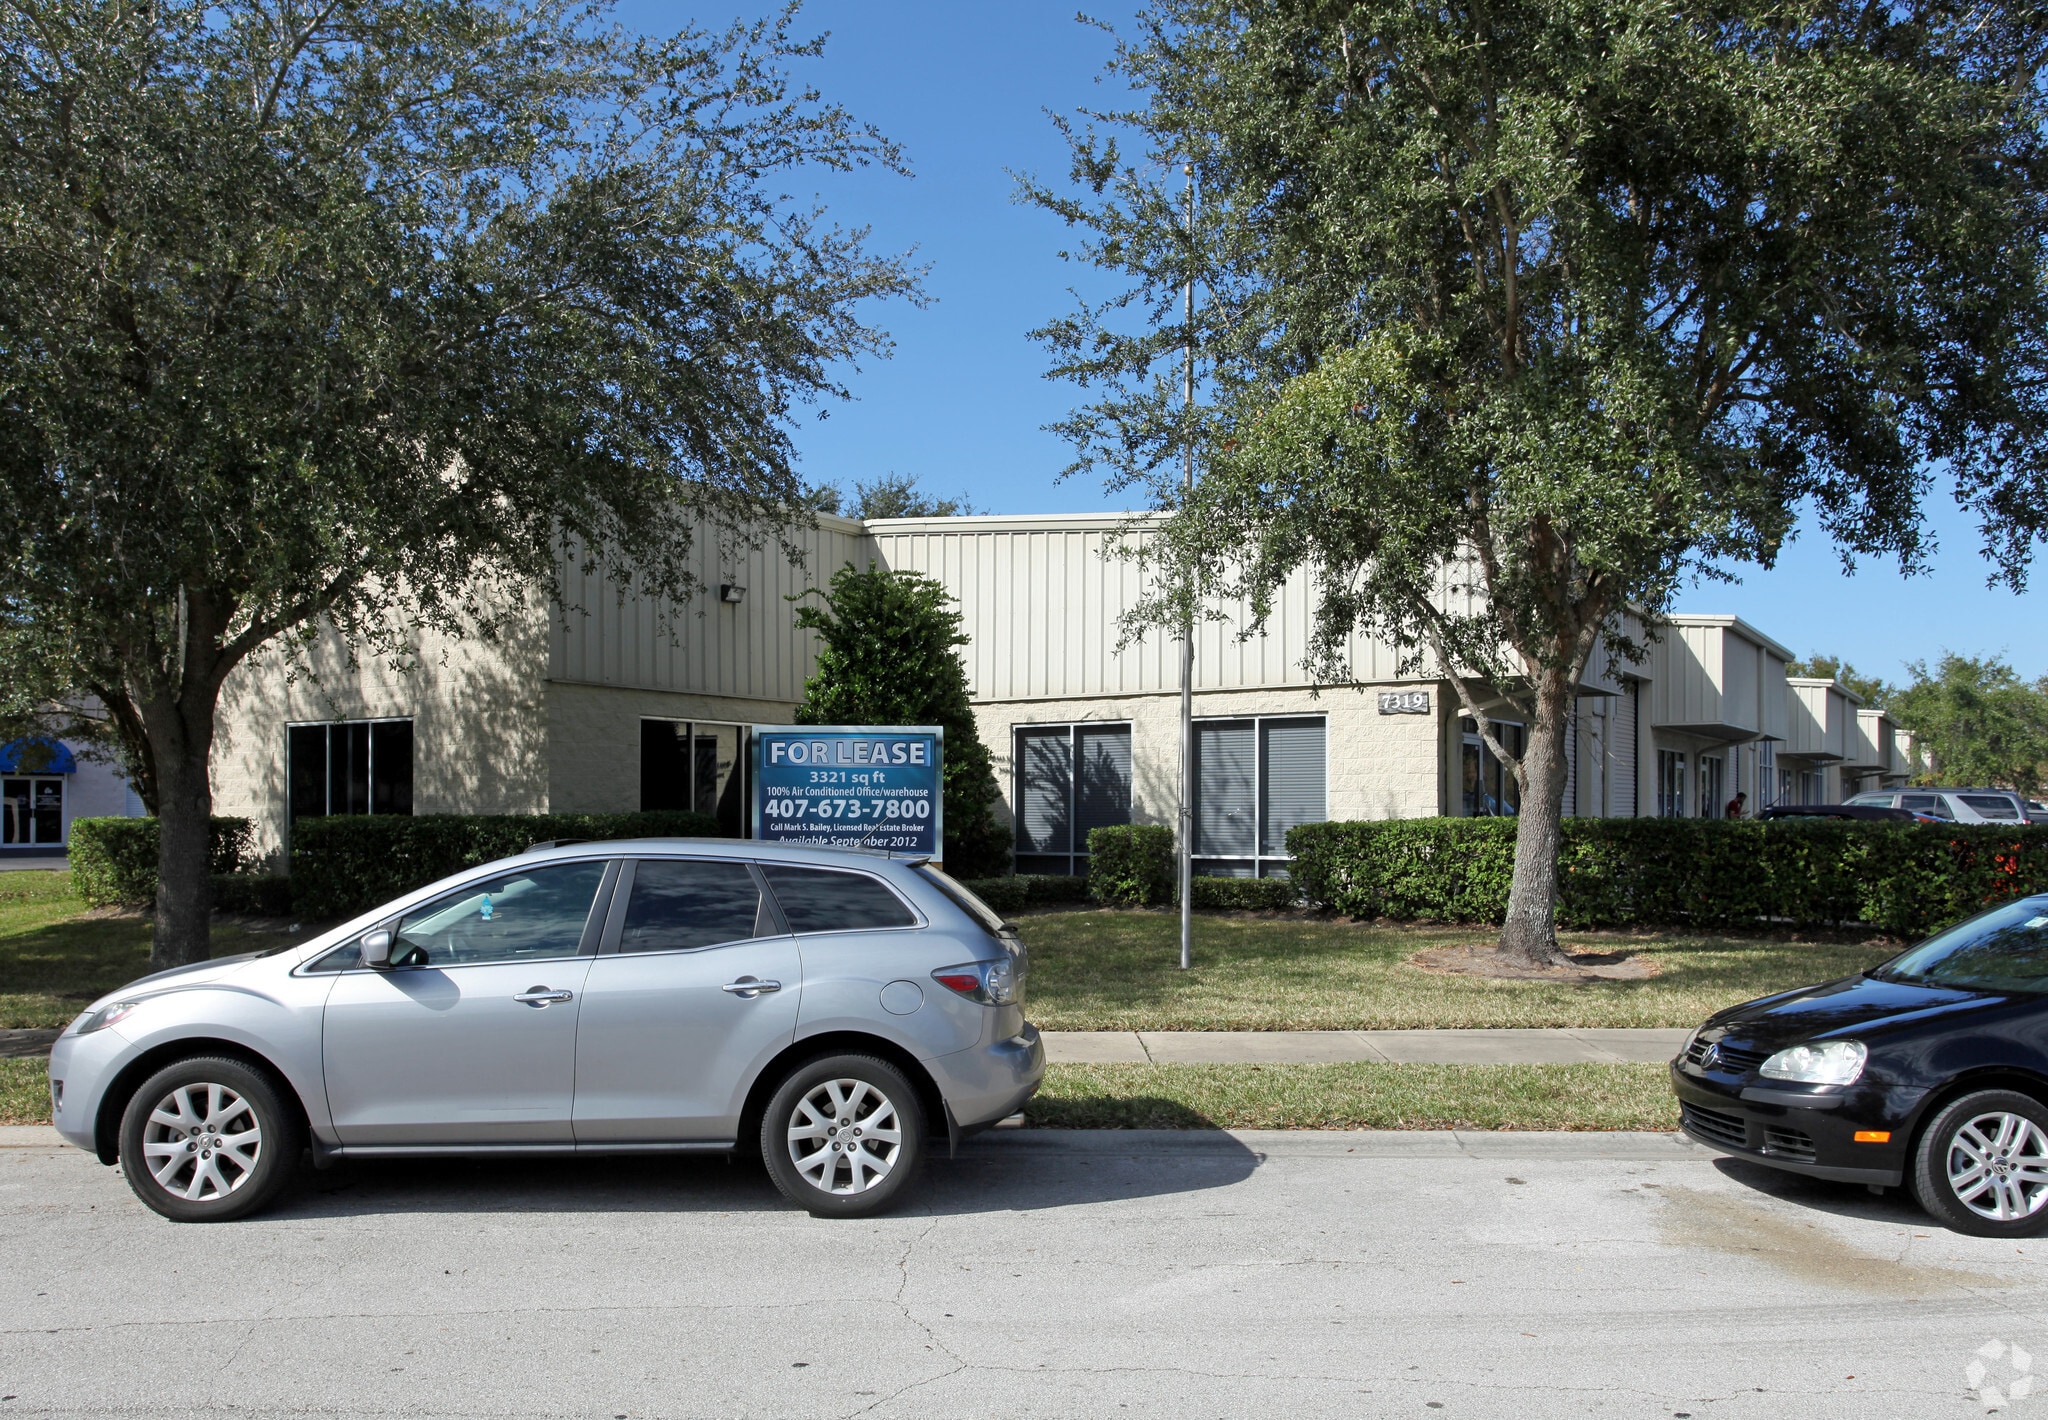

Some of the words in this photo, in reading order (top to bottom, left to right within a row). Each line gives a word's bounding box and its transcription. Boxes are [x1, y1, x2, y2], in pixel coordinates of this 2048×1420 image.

[1382, 694, 1423, 709] 7319
[771, 742, 828, 764] FOR
[837, 742, 925, 764] LEASE
[810, 771, 846, 783] 3321
[851, 773, 869, 786] sq
[872, 771, 885, 783] ft
[767, 786, 790, 796] 100%
[791, 786, 804, 796] Air
[805, 786, 854, 796] Conditioned
[857, 786, 929, 797] Office/warehouse
[765, 799, 930, 819] 407-673-7800
[770, 823, 783, 831] Call
[784, 823, 801, 831] Mark
[802, 823, 809, 831] S.
[809, 823, 832, 833] Bailey,
[833, 823, 862, 831] Licensed
[880, 823, 901, 832] Estate
[902, 823, 925, 832] Broker
[890, 836, 918, 847] 2012
